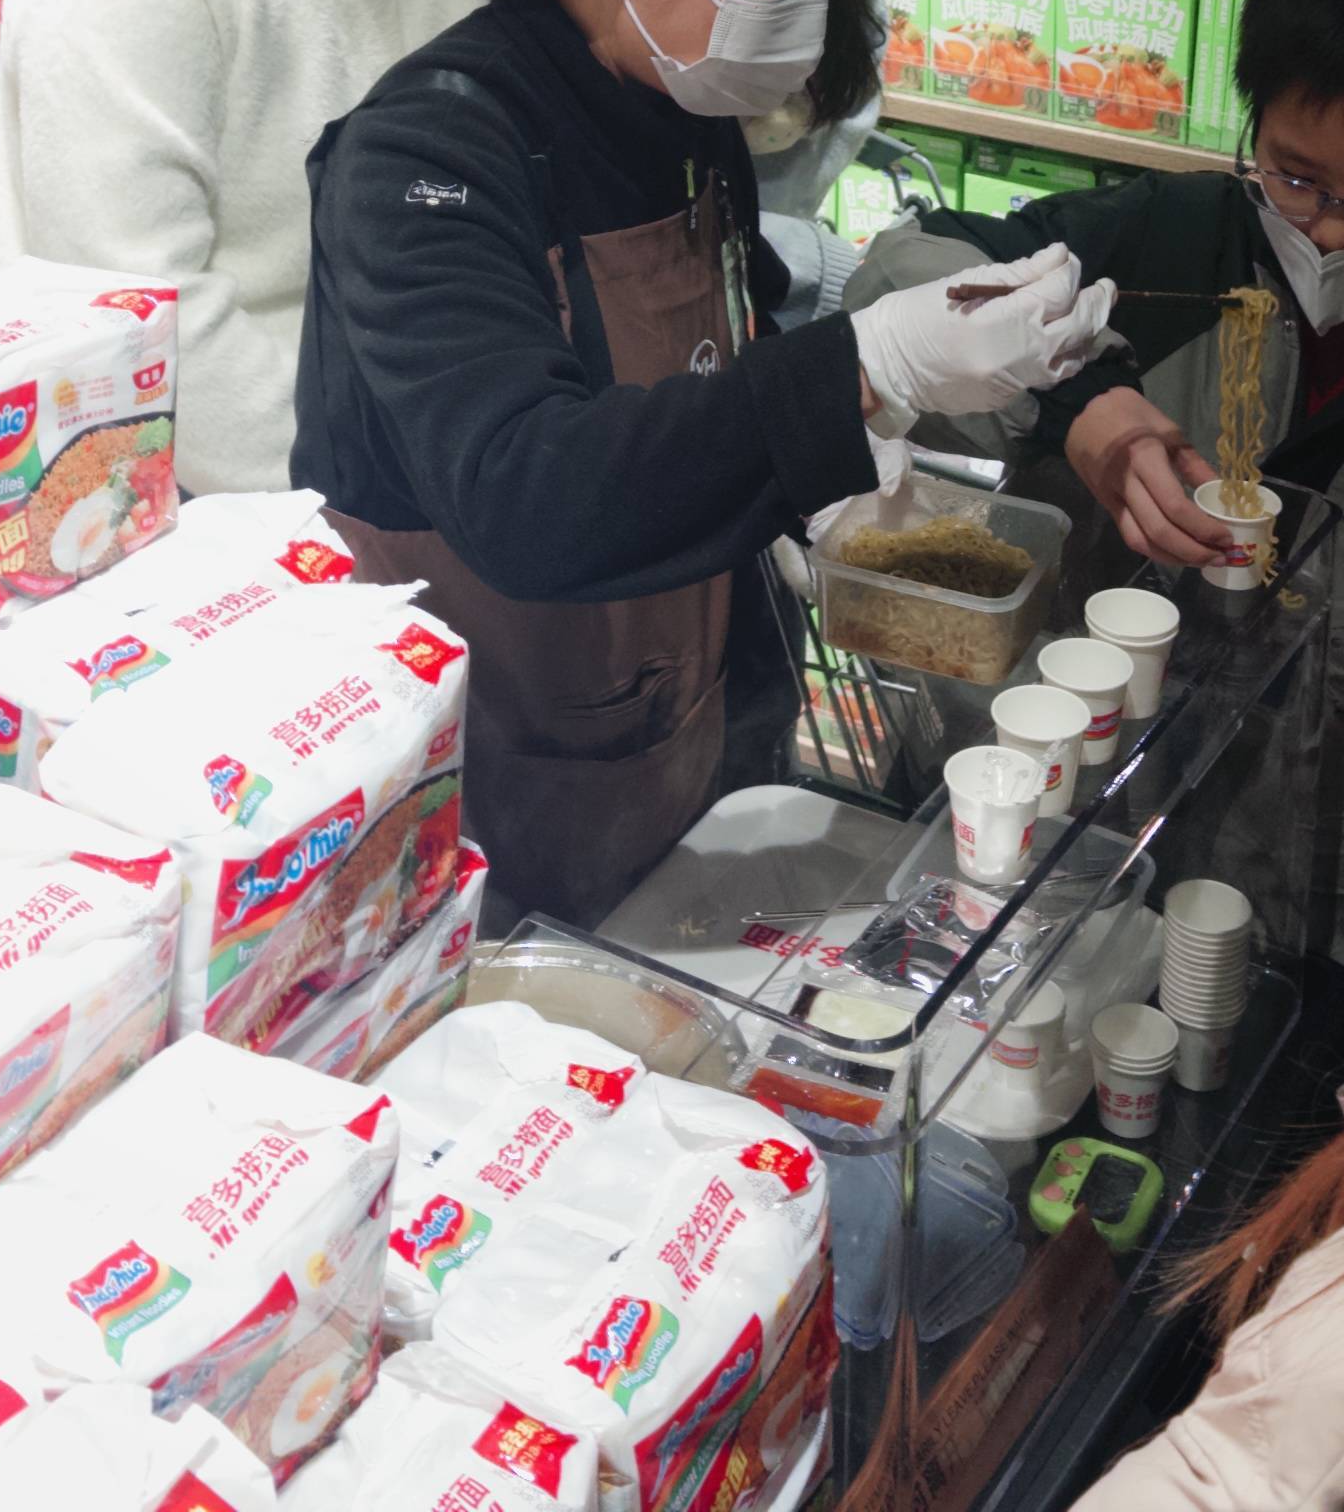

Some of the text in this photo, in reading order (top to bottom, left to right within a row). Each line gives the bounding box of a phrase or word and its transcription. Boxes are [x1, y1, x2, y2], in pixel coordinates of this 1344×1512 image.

[1067, 16, 1180, 59] 风味汤底
[267, 675, 373, 749] 营多捞面
